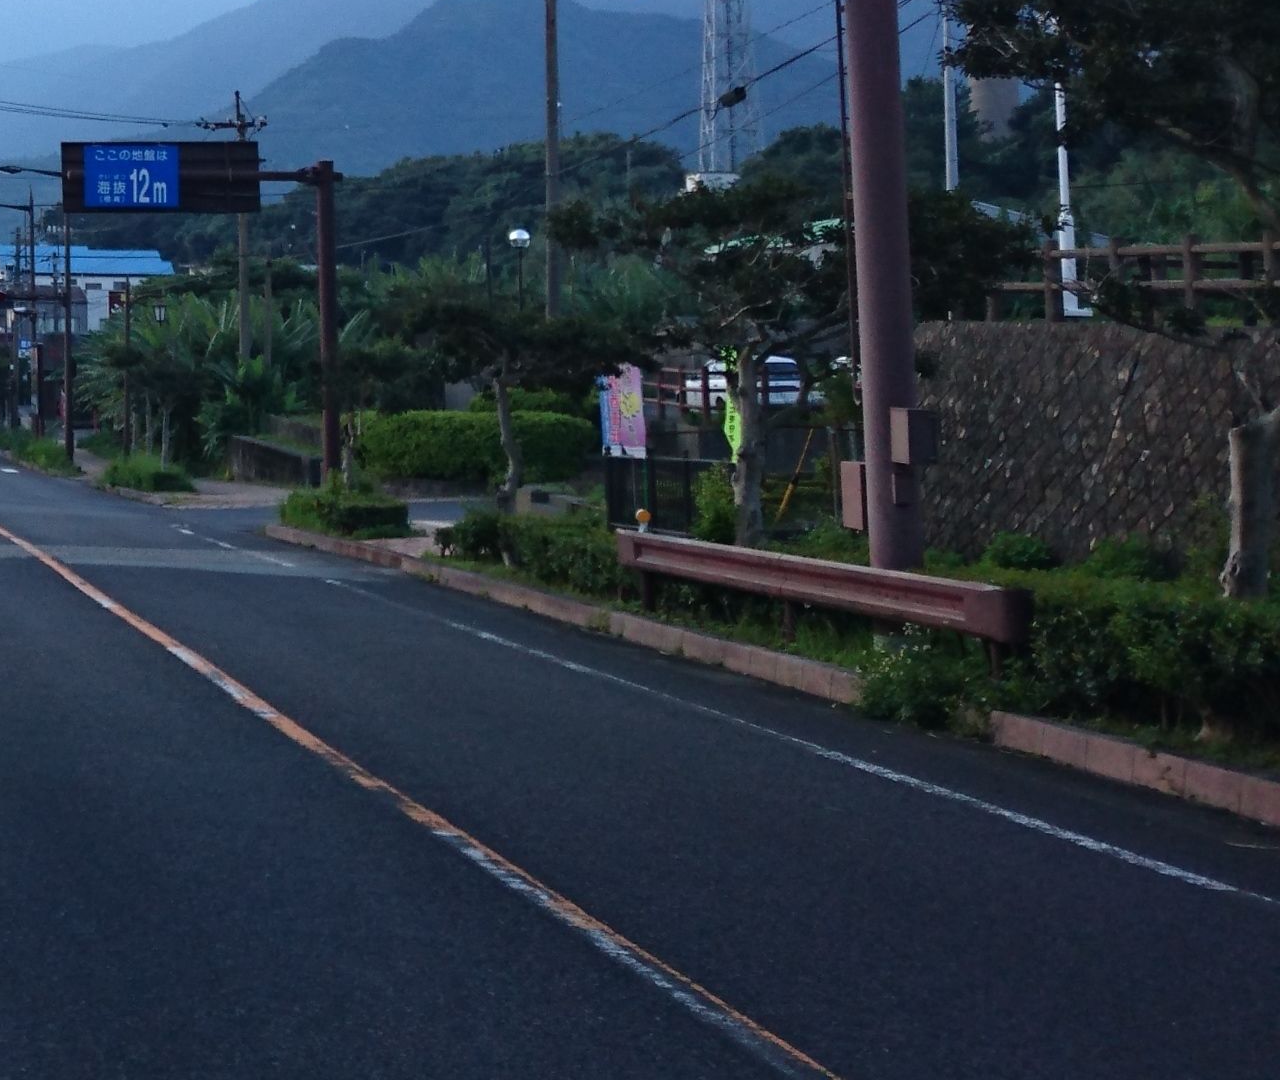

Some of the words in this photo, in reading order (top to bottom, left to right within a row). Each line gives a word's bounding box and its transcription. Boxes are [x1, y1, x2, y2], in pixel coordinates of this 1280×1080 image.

[94, 149, 168, 161] ここの地盤は
